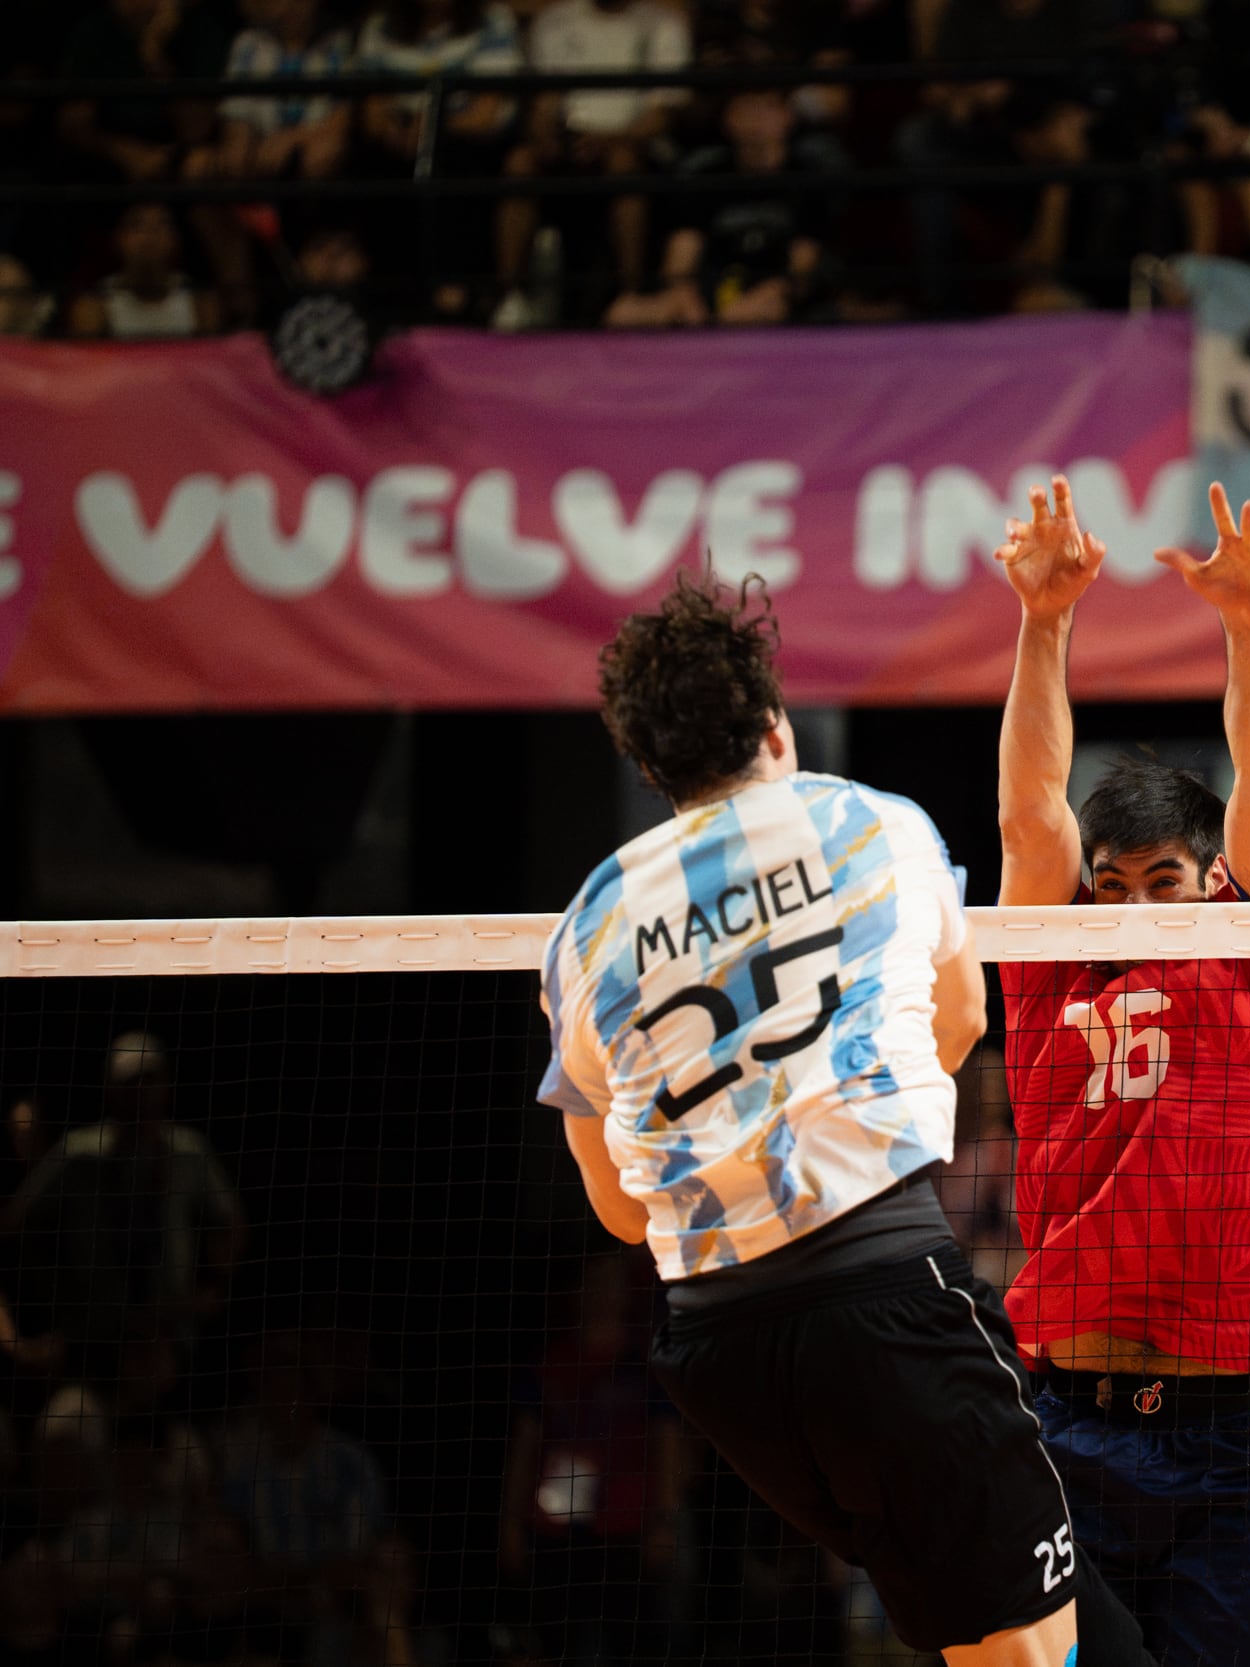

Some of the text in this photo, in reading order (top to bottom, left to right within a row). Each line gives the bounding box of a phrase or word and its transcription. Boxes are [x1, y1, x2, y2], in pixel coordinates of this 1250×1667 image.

[74, 459, 803, 603] VUELVE
[635, 858, 833, 977] MACIEL
[633, 925, 845, 1122] 25
[1063, 987, 1172, 1110] 16
[1033, 1522, 1074, 1594] 25
